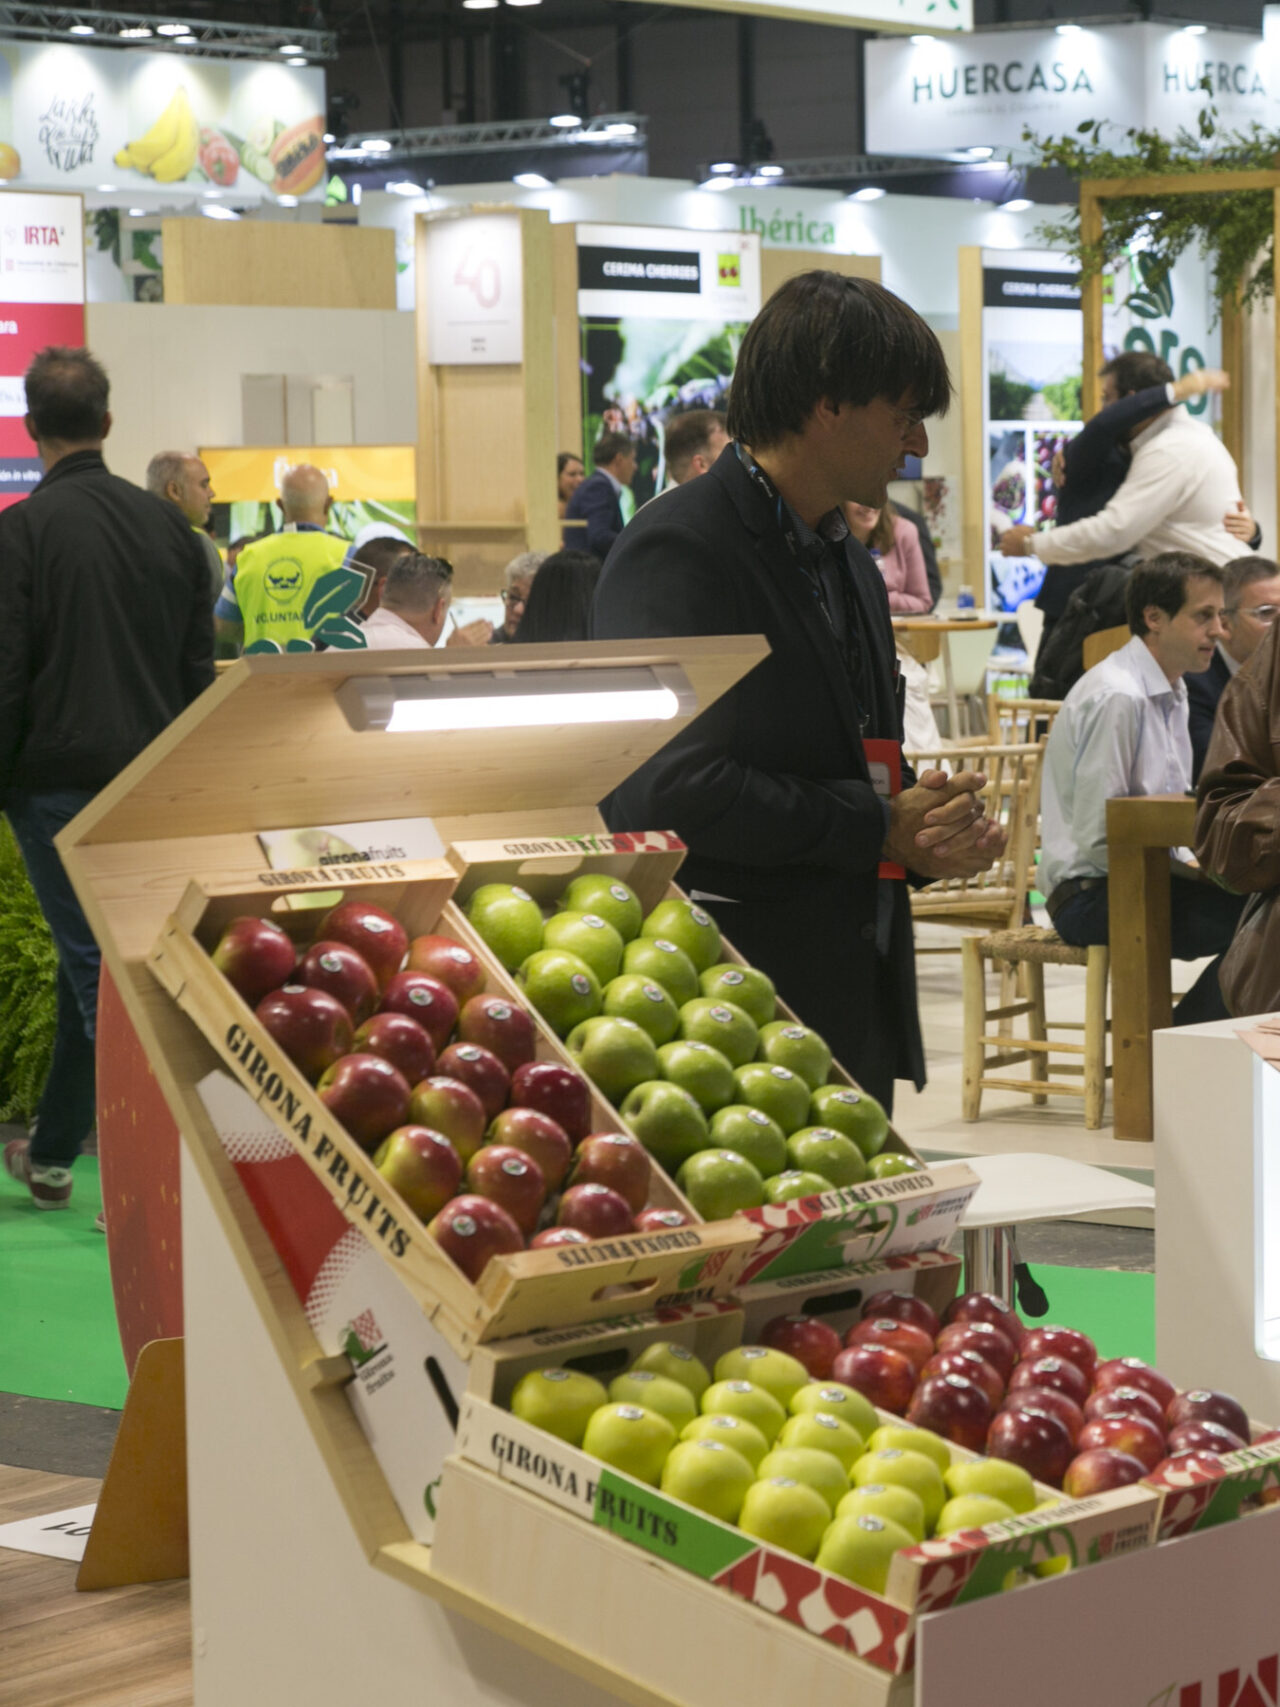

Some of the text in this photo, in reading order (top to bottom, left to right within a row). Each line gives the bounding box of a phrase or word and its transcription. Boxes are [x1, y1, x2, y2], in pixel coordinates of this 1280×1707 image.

[913, 61, 1094, 102] HUERCASA
[24, 225, 60, 246] IRTA
[646, 263, 699, 281] CHERRIES
[258, 864, 406, 887] GIRONA FRUITS
[226, 1023, 412, 1258] GIRONA FRUITS
[870, 1174, 934, 1198] GIRONA
[556, 1231, 702, 1268] GIRONA FRUITS
[491, 1432, 678, 1547] GIRONA FRUITS
